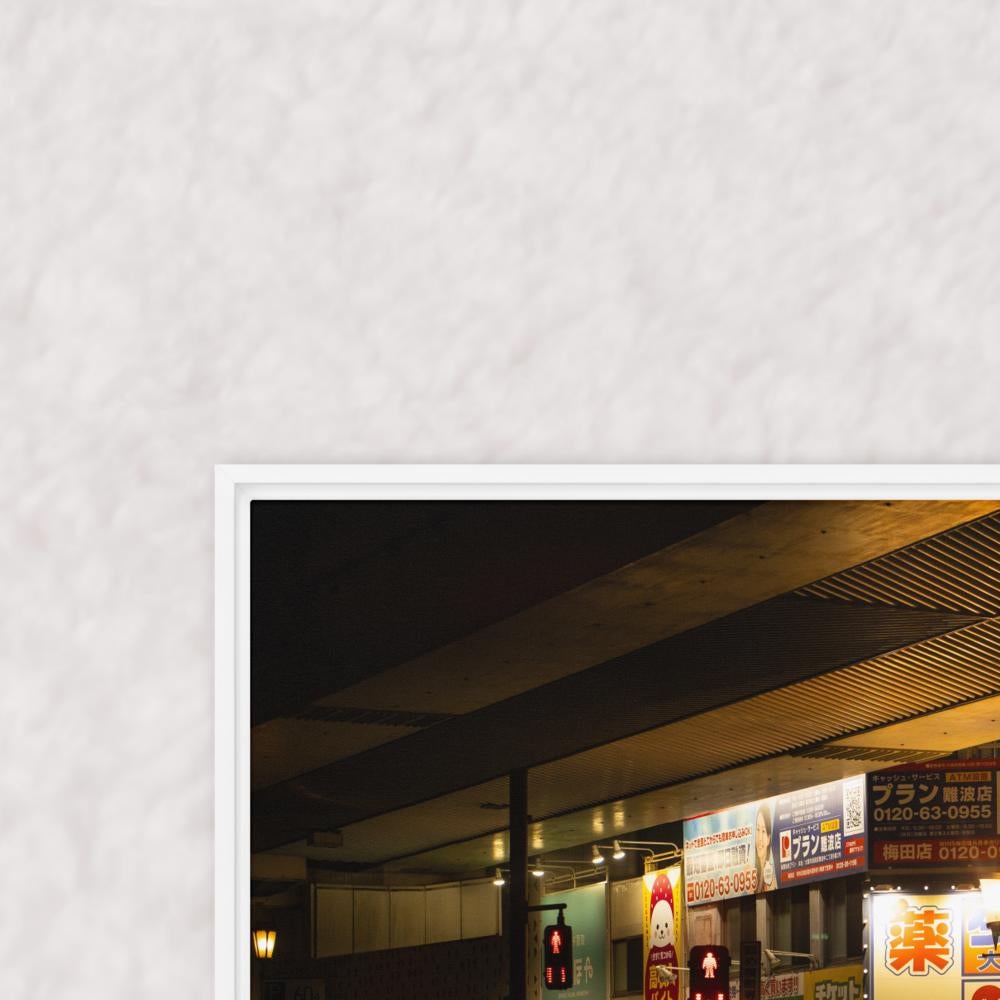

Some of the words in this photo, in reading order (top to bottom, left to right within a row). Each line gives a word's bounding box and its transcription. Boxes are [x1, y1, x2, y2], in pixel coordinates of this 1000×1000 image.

[872, 784, 938, 806] プラン
[943, 786, 993, 803] 難波店
[873, 805, 992, 822] 0120-63-0955
[793, 834, 820, 860] プラン
[882, 843, 933, 861] 梅田店
[694, 868, 758, 901] 0120-63-0955
[889, 905, 951, 973] 薬
